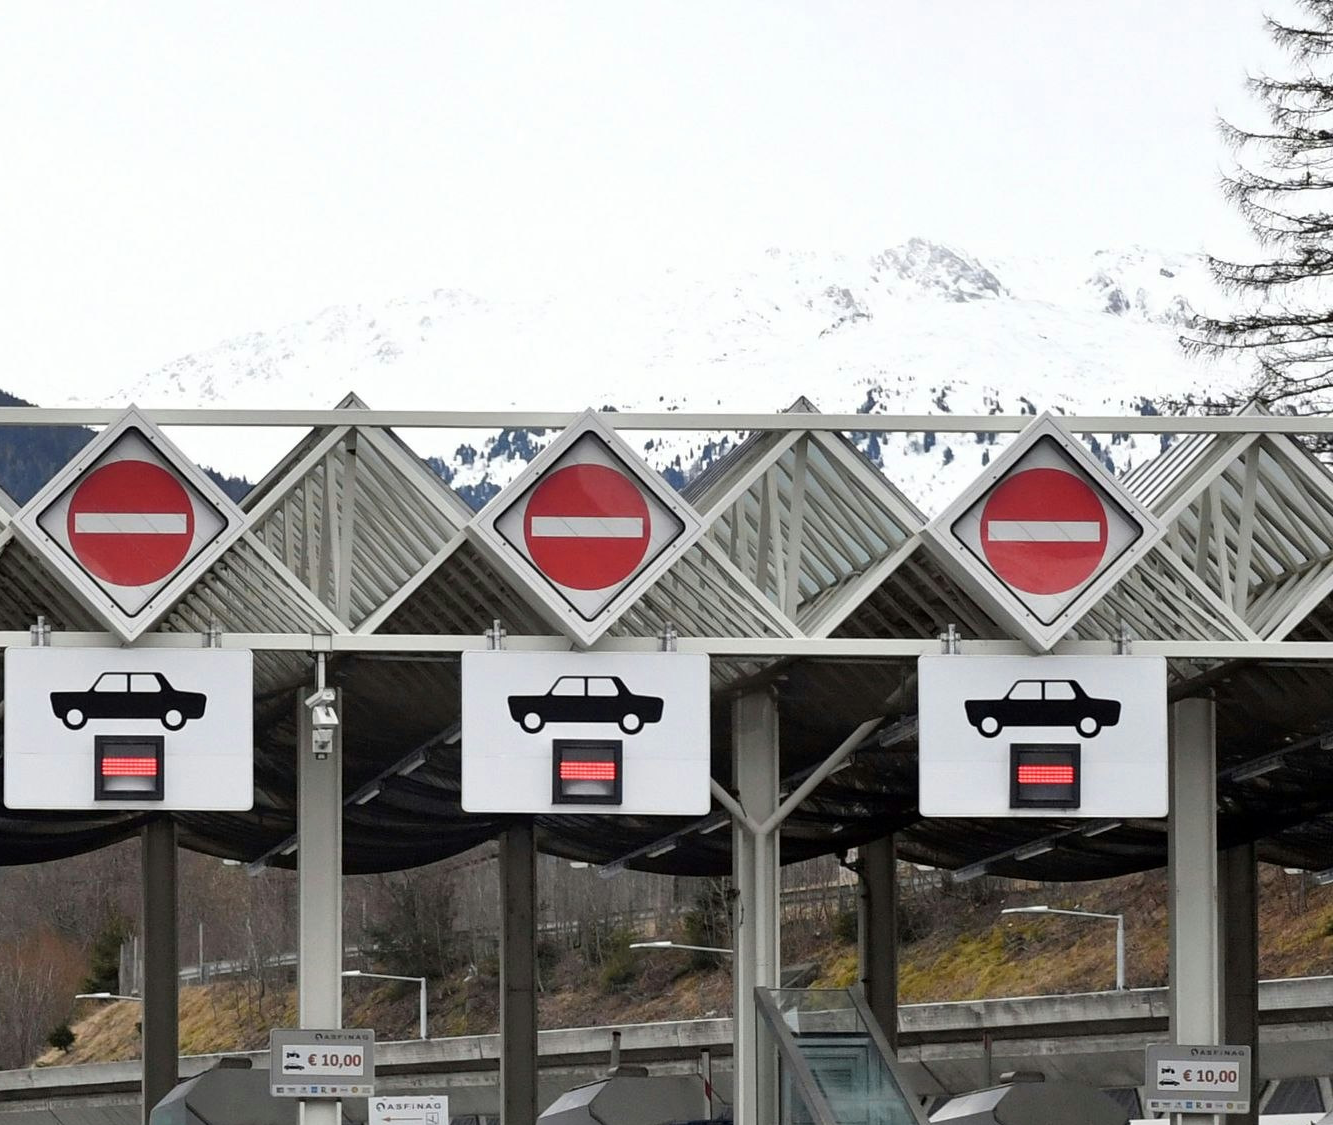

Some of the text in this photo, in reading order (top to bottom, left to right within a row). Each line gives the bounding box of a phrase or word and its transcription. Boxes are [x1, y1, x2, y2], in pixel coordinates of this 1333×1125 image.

[308, 1053, 362, 1068] € 10,00
[1183, 1069, 1237, 1084] € 10,00
[387, 1102, 442, 1110] ASFINAG
